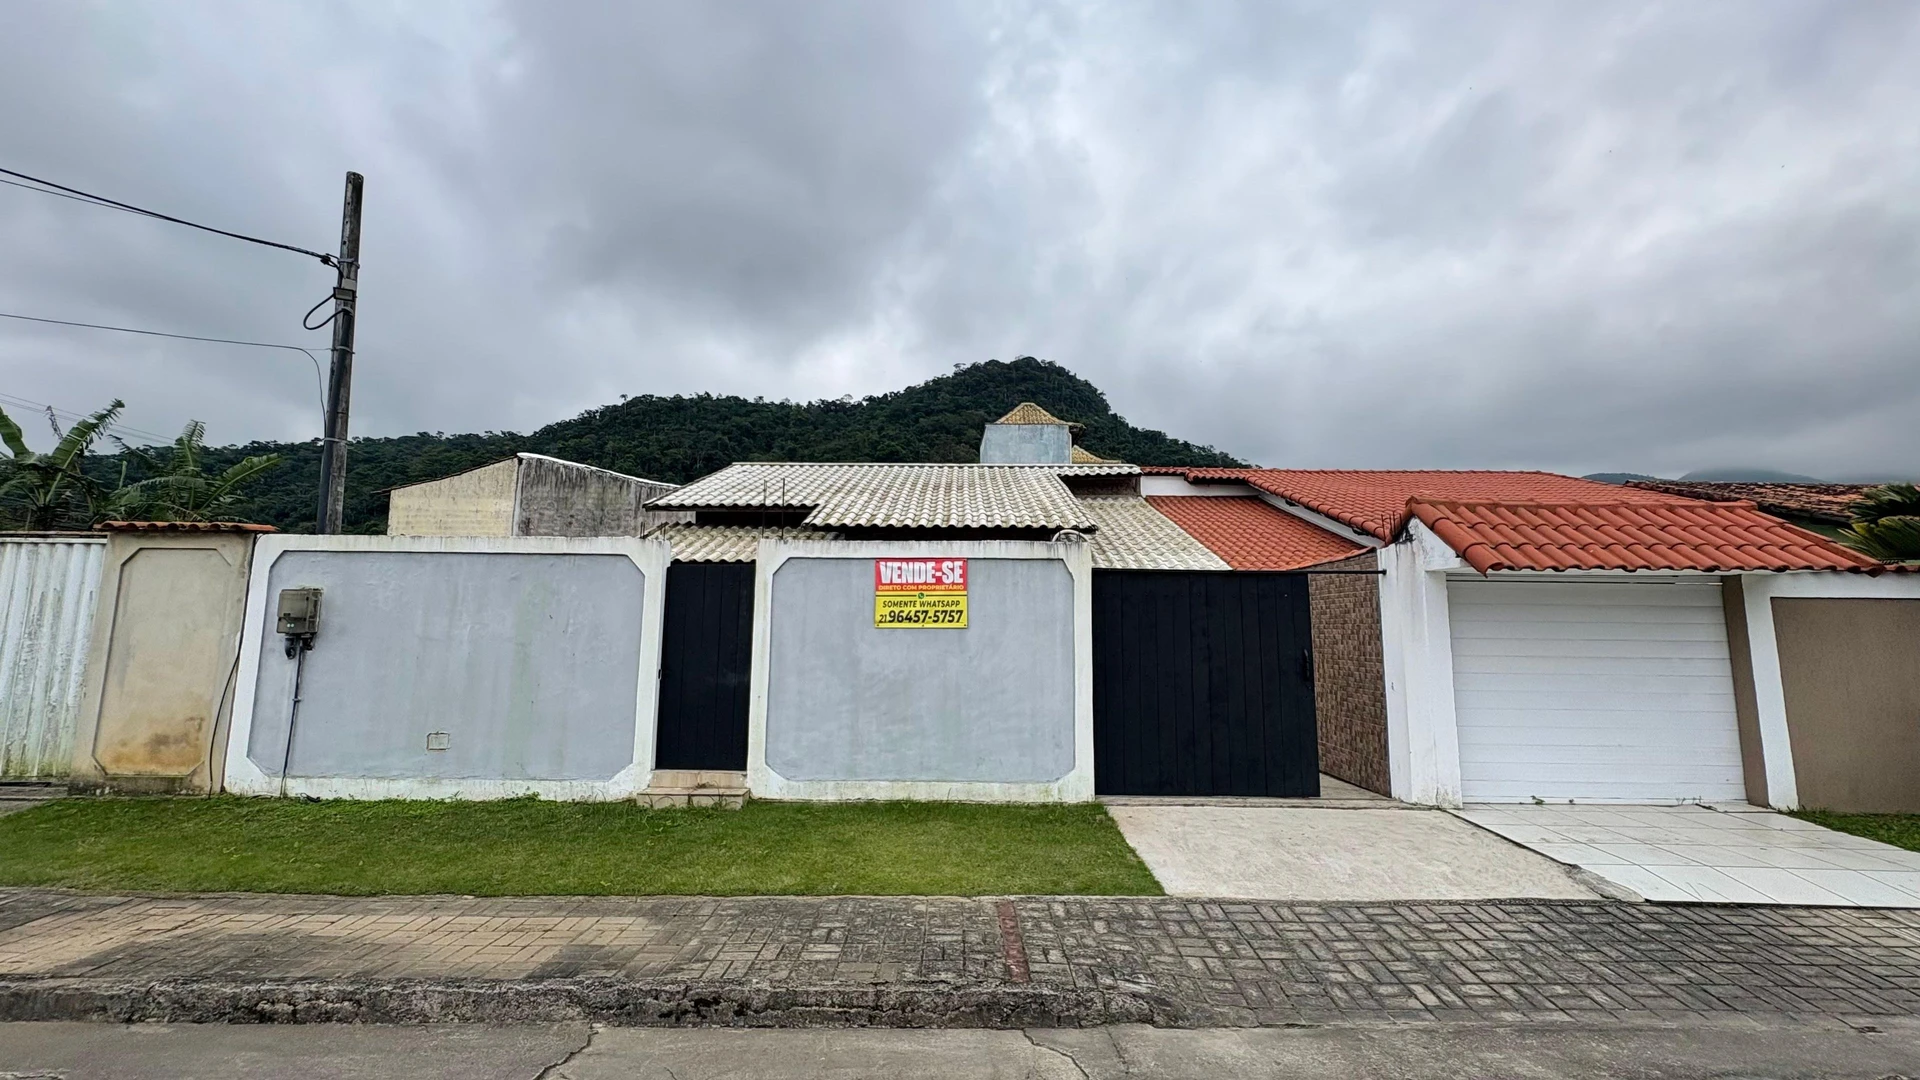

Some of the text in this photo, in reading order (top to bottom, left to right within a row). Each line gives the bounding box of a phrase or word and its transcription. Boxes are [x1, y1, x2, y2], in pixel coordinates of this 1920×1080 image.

[880, 561, 964, 584] VENDE-SE
[879, 610, 964, 623] 21 96457-5757
